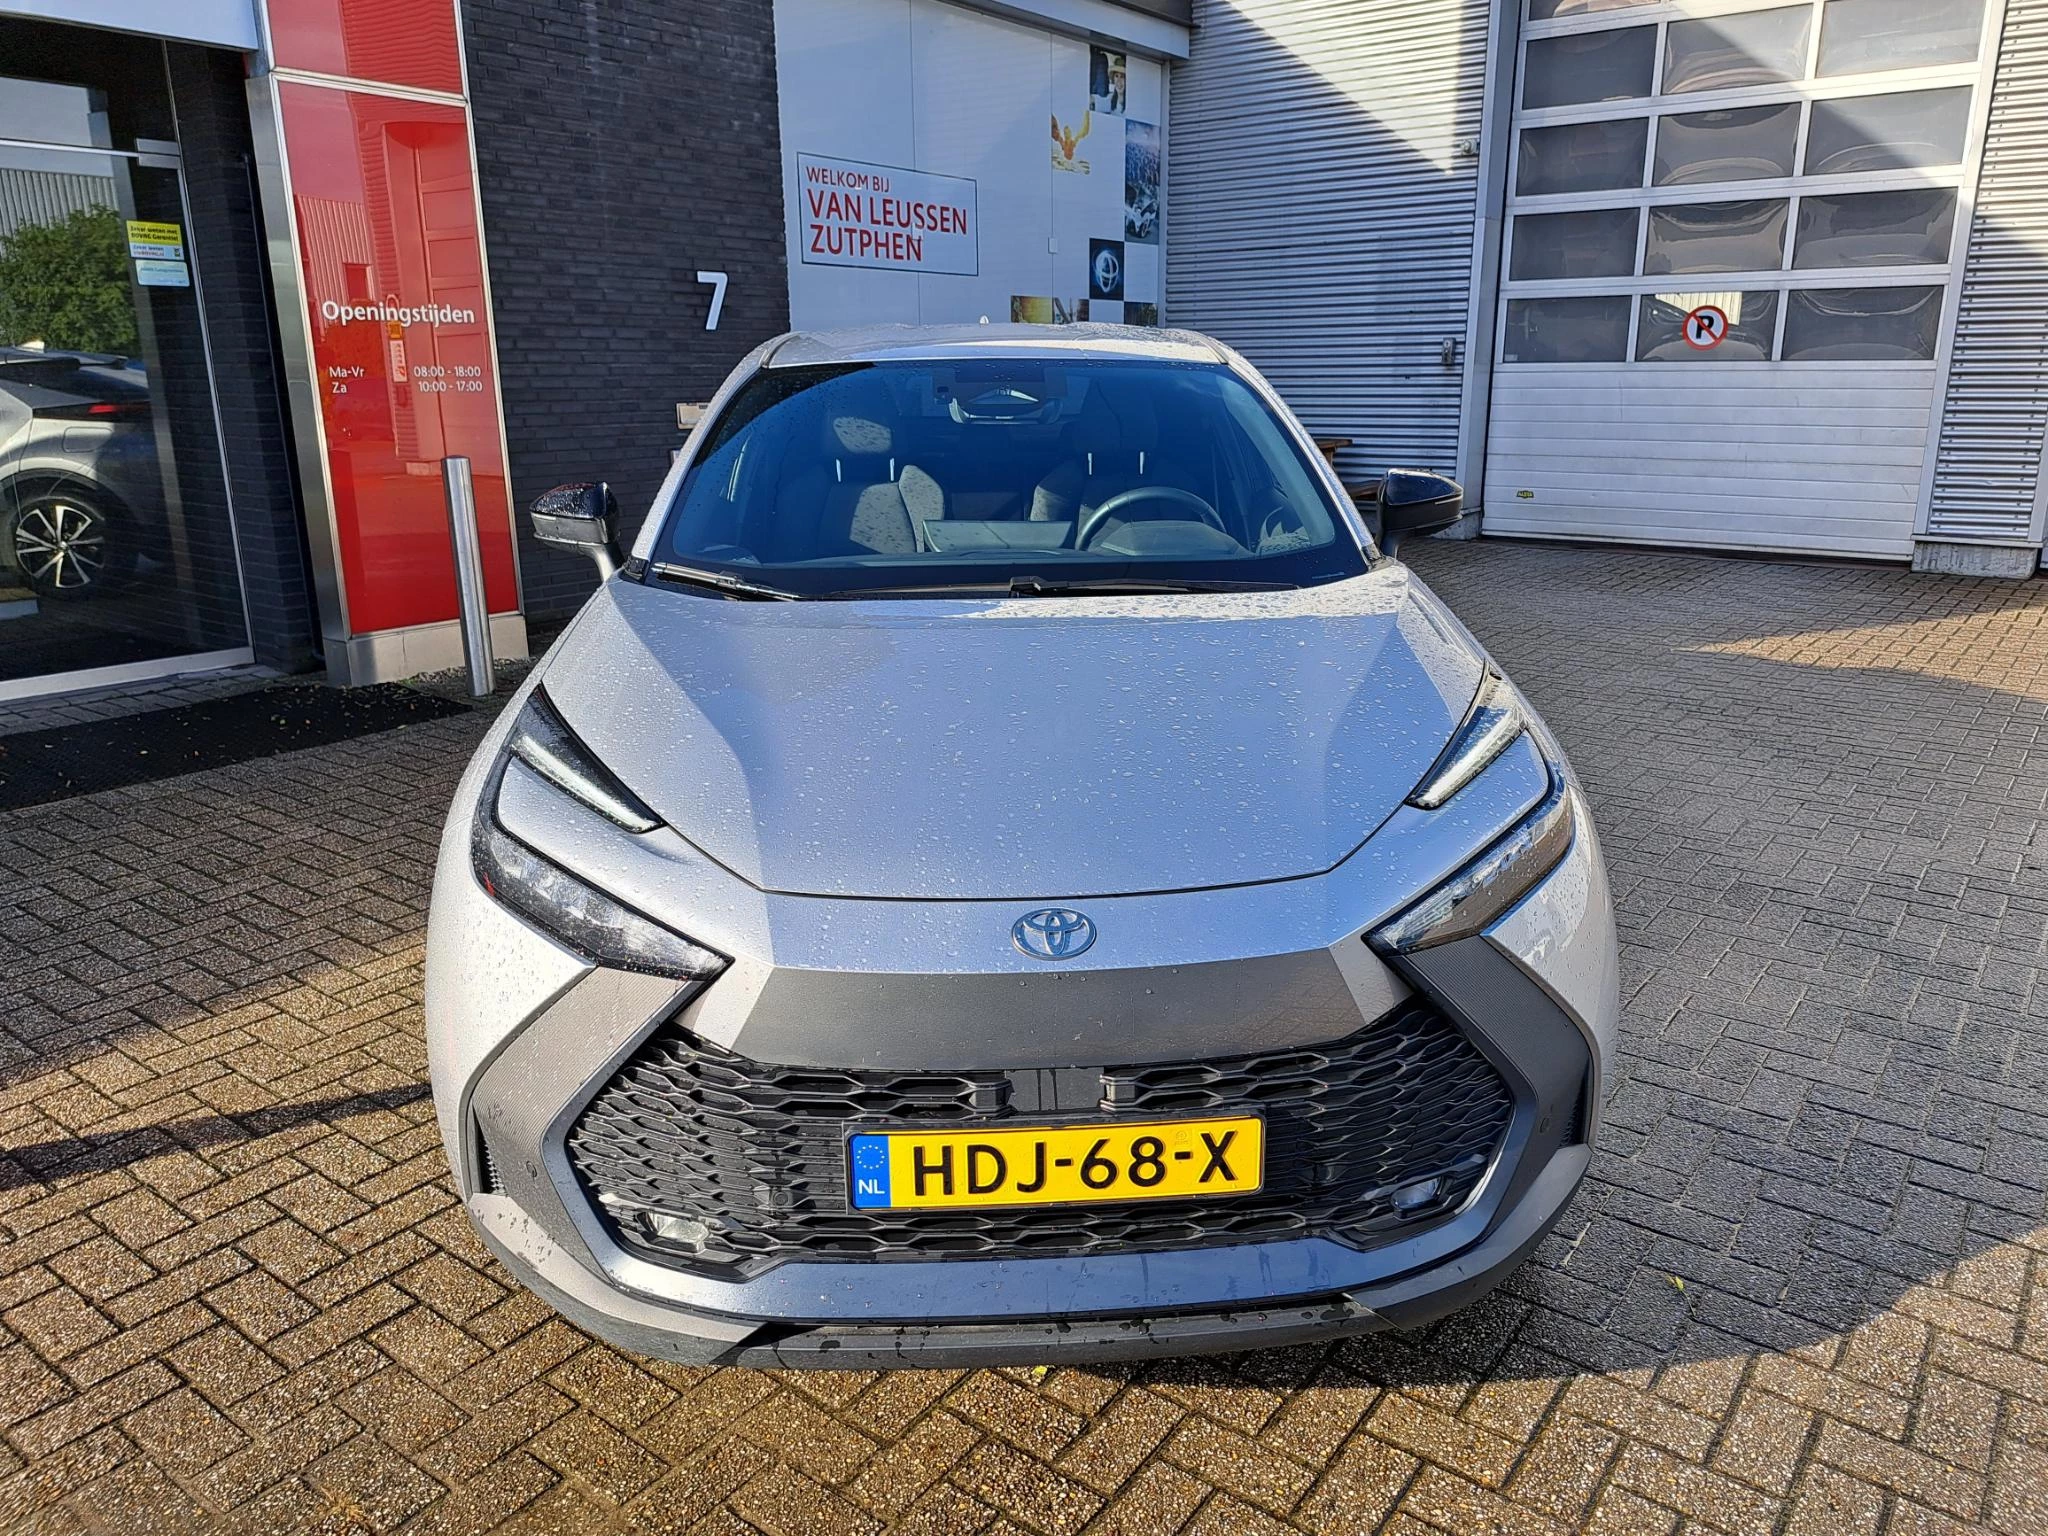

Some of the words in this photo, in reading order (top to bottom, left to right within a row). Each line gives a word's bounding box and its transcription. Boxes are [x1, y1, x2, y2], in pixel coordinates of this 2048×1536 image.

[806, 166, 869, 190] WELKOM
[872, 176, 890, 193] BIJ
[807, 188, 862, 223] VAN
[869, 196, 967, 235] LEUSSEN
[810, 223, 922, 262] ZUTPHEN
[322, 300, 475, 327] Openingstijden
[696, 270, 728, 331] 7
[1695, 315, 1715, 339] P
[329, 365, 365, 378] Ma-Vr
[413, 366, 445, 377] 08:00
[454, 366, 481, 377] 18:00
[332, 381, 347, 394] Za
[418, 381, 447, 392] 10:00
[456, 381, 483, 392] 17:00
[913, 1130, 1239, 1197] HDJ-68-X
[857, 1178, 885, 1195] NL
